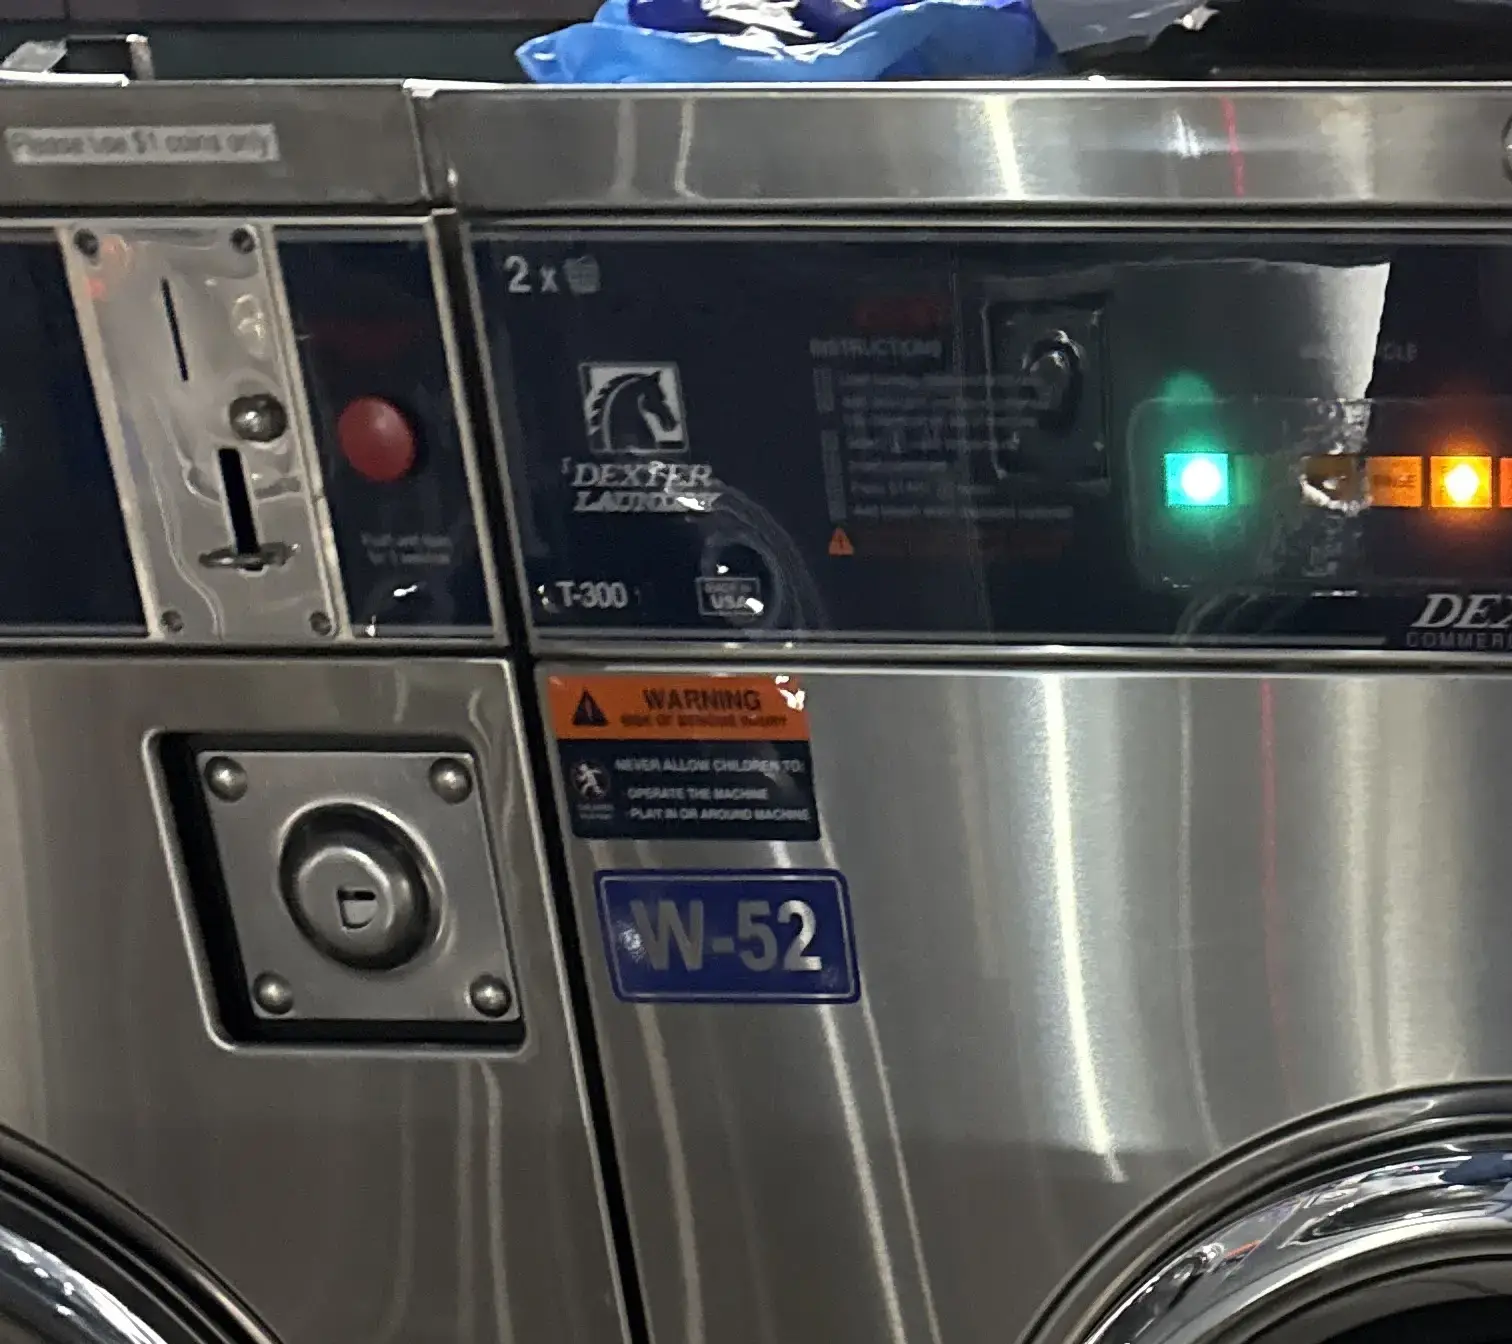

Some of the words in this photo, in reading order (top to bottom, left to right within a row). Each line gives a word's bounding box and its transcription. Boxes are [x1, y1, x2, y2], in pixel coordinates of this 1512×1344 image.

[504, 255, 532, 293] 2
[539, 267, 559, 293] x
[570, 463, 715, 488] DEXTER
[555, 580, 629, 609] T-300
[642, 688, 762, 711] WARNING
[687, 787, 712, 800] THE
[629, 899, 823, 972] W-52
